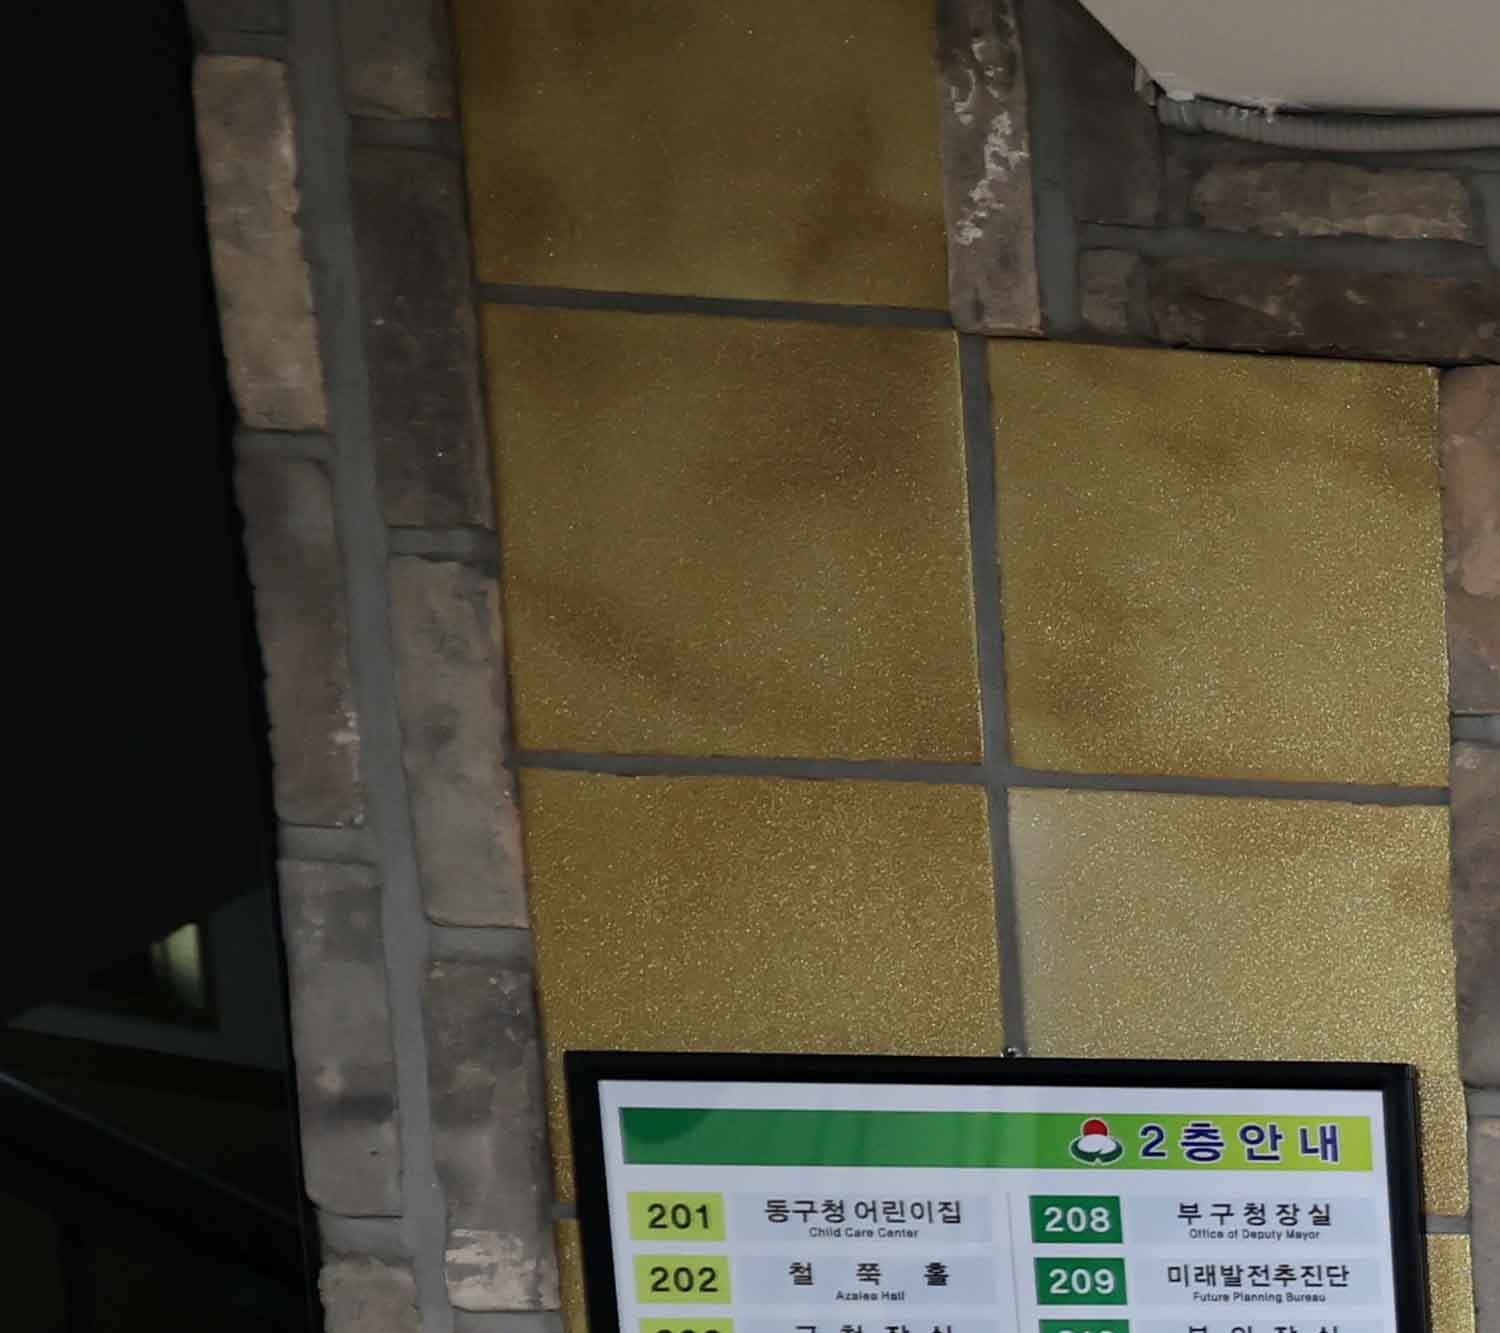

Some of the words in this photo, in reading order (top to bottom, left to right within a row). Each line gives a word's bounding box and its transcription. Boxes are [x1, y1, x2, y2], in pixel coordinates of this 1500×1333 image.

[647, 1203, 709, 1230] 201
[764, 1199, 846, 1224] 동구청
[854, 1199, 961, 1225] 어린이집
[1044, 1206, 1111, 1233] 208
[808, 1226, 842, 1238] Child
[844, 1226, 875, 1238] Care
[877, 1227, 919, 1238] Center
[1189, 1228, 1225, 1239] Office
[1227, 1228, 1239, 1240] of
[1241, 1228, 1283, 1241] Deputy
[1285, 1229, 1320, 1241] Mayor
[650, 1266, 719, 1293] 202
[1049, 1268, 1116, 1295] 209
[1167, 1264, 1350, 1288] 미래발전추진단
[835, 1290, 878, 1301] Azalea
[881, 1290, 905, 1302] Hall
[1192, 1291, 1231, 1303] Future
[1232, 1291, 1283, 1305] Planning
[1285, 1291, 1327, 1303] Bureau
